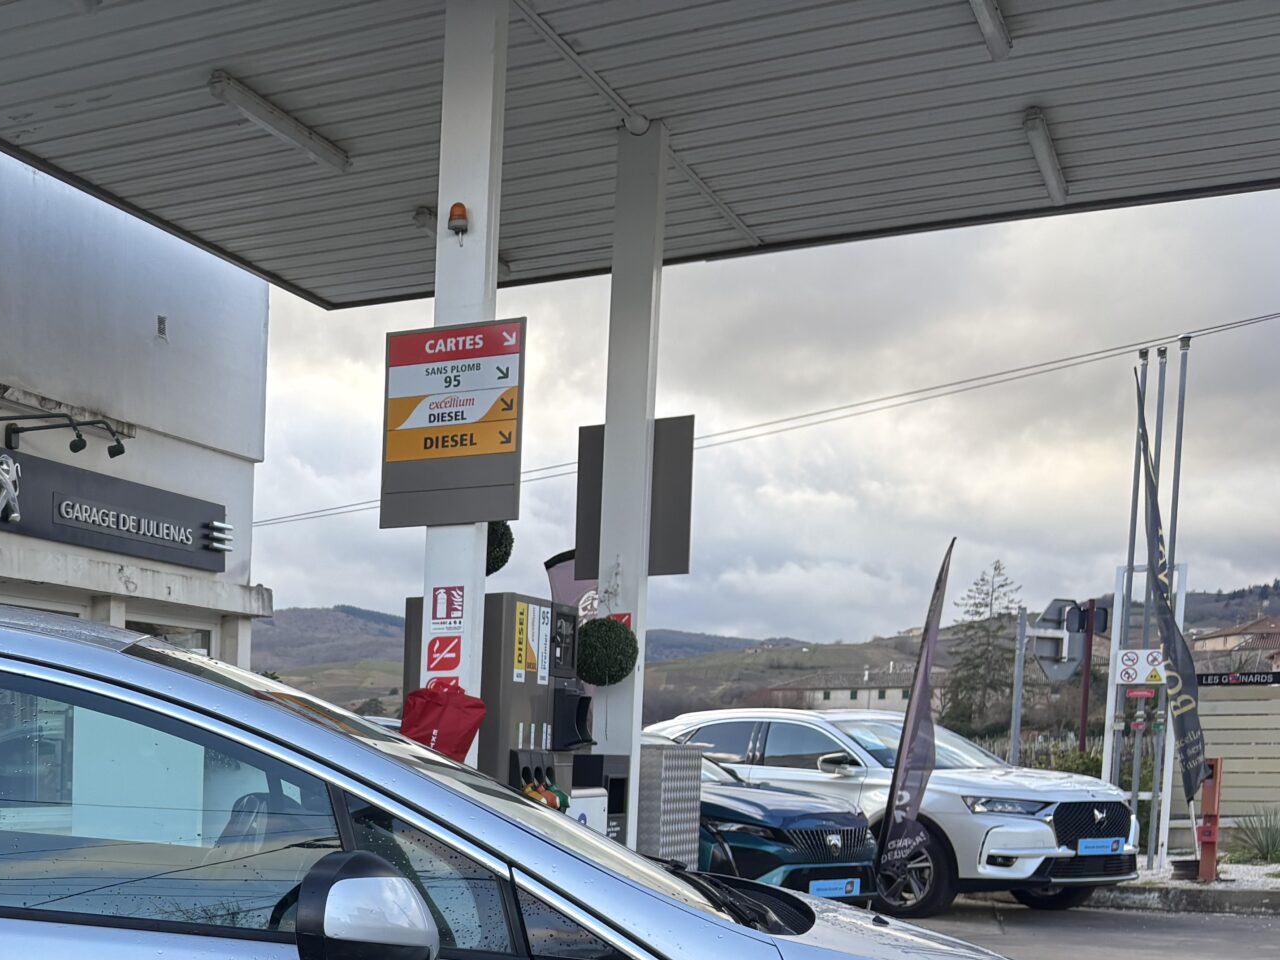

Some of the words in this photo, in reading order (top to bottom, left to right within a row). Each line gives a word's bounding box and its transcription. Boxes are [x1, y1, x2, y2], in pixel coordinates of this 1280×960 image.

[424, 334, 484, 354] CARTES
[425, 365, 448, 376] SANS
[450, 362, 481, 374] PLOMB
[443, 374, 461, 388] 95
[428, 394, 475, 410] excellium
[428, 410, 467, 424] DIESEL
[423, 432, 477, 450] DIESEL
[60, 500, 117, 529] GARAGE
[118, 513, 137, 533] DE
[137, 518, 193, 545] JULIENAS
[541, 610, 550, 626] 95
[517, 608, 525, 664] DIESEL
[1202, 675, 1219, 684] LES
